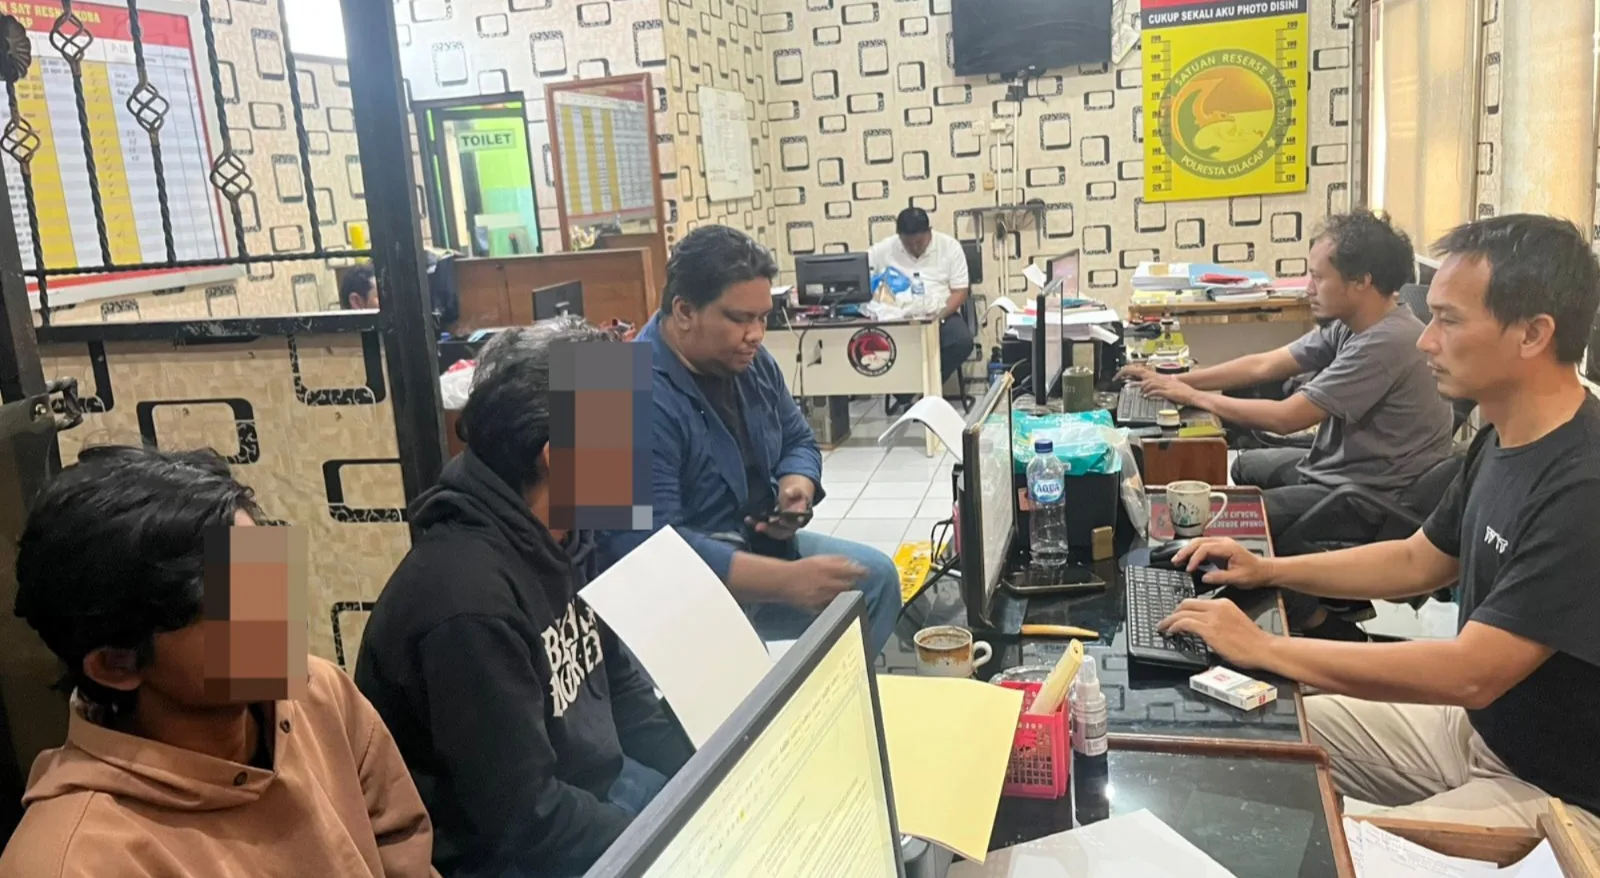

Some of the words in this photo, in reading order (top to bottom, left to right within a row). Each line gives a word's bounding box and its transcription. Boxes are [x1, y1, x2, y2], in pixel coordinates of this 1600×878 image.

[10, 2, 31, 15] SAT
[1148, 12, 1180, 24] CUKUP
[1181, 8, 1214, 21] SEKALI
[1215, 5, 1236, 18] AKU
[1237, 2, 1269, 15] PHOTO
[1270, 0, 1299, 12] DISINI
[1175, 55, 1216, 86] SATUAN
[1222, 53, 1268, 75] RESERSE
[460, 133, 511, 146] TOILET
[1181, 155, 1226, 176] POLRESTA
[1227, 150, 1264, 174] CILACAP
[1037, 483, 1060, 493] AQUA
